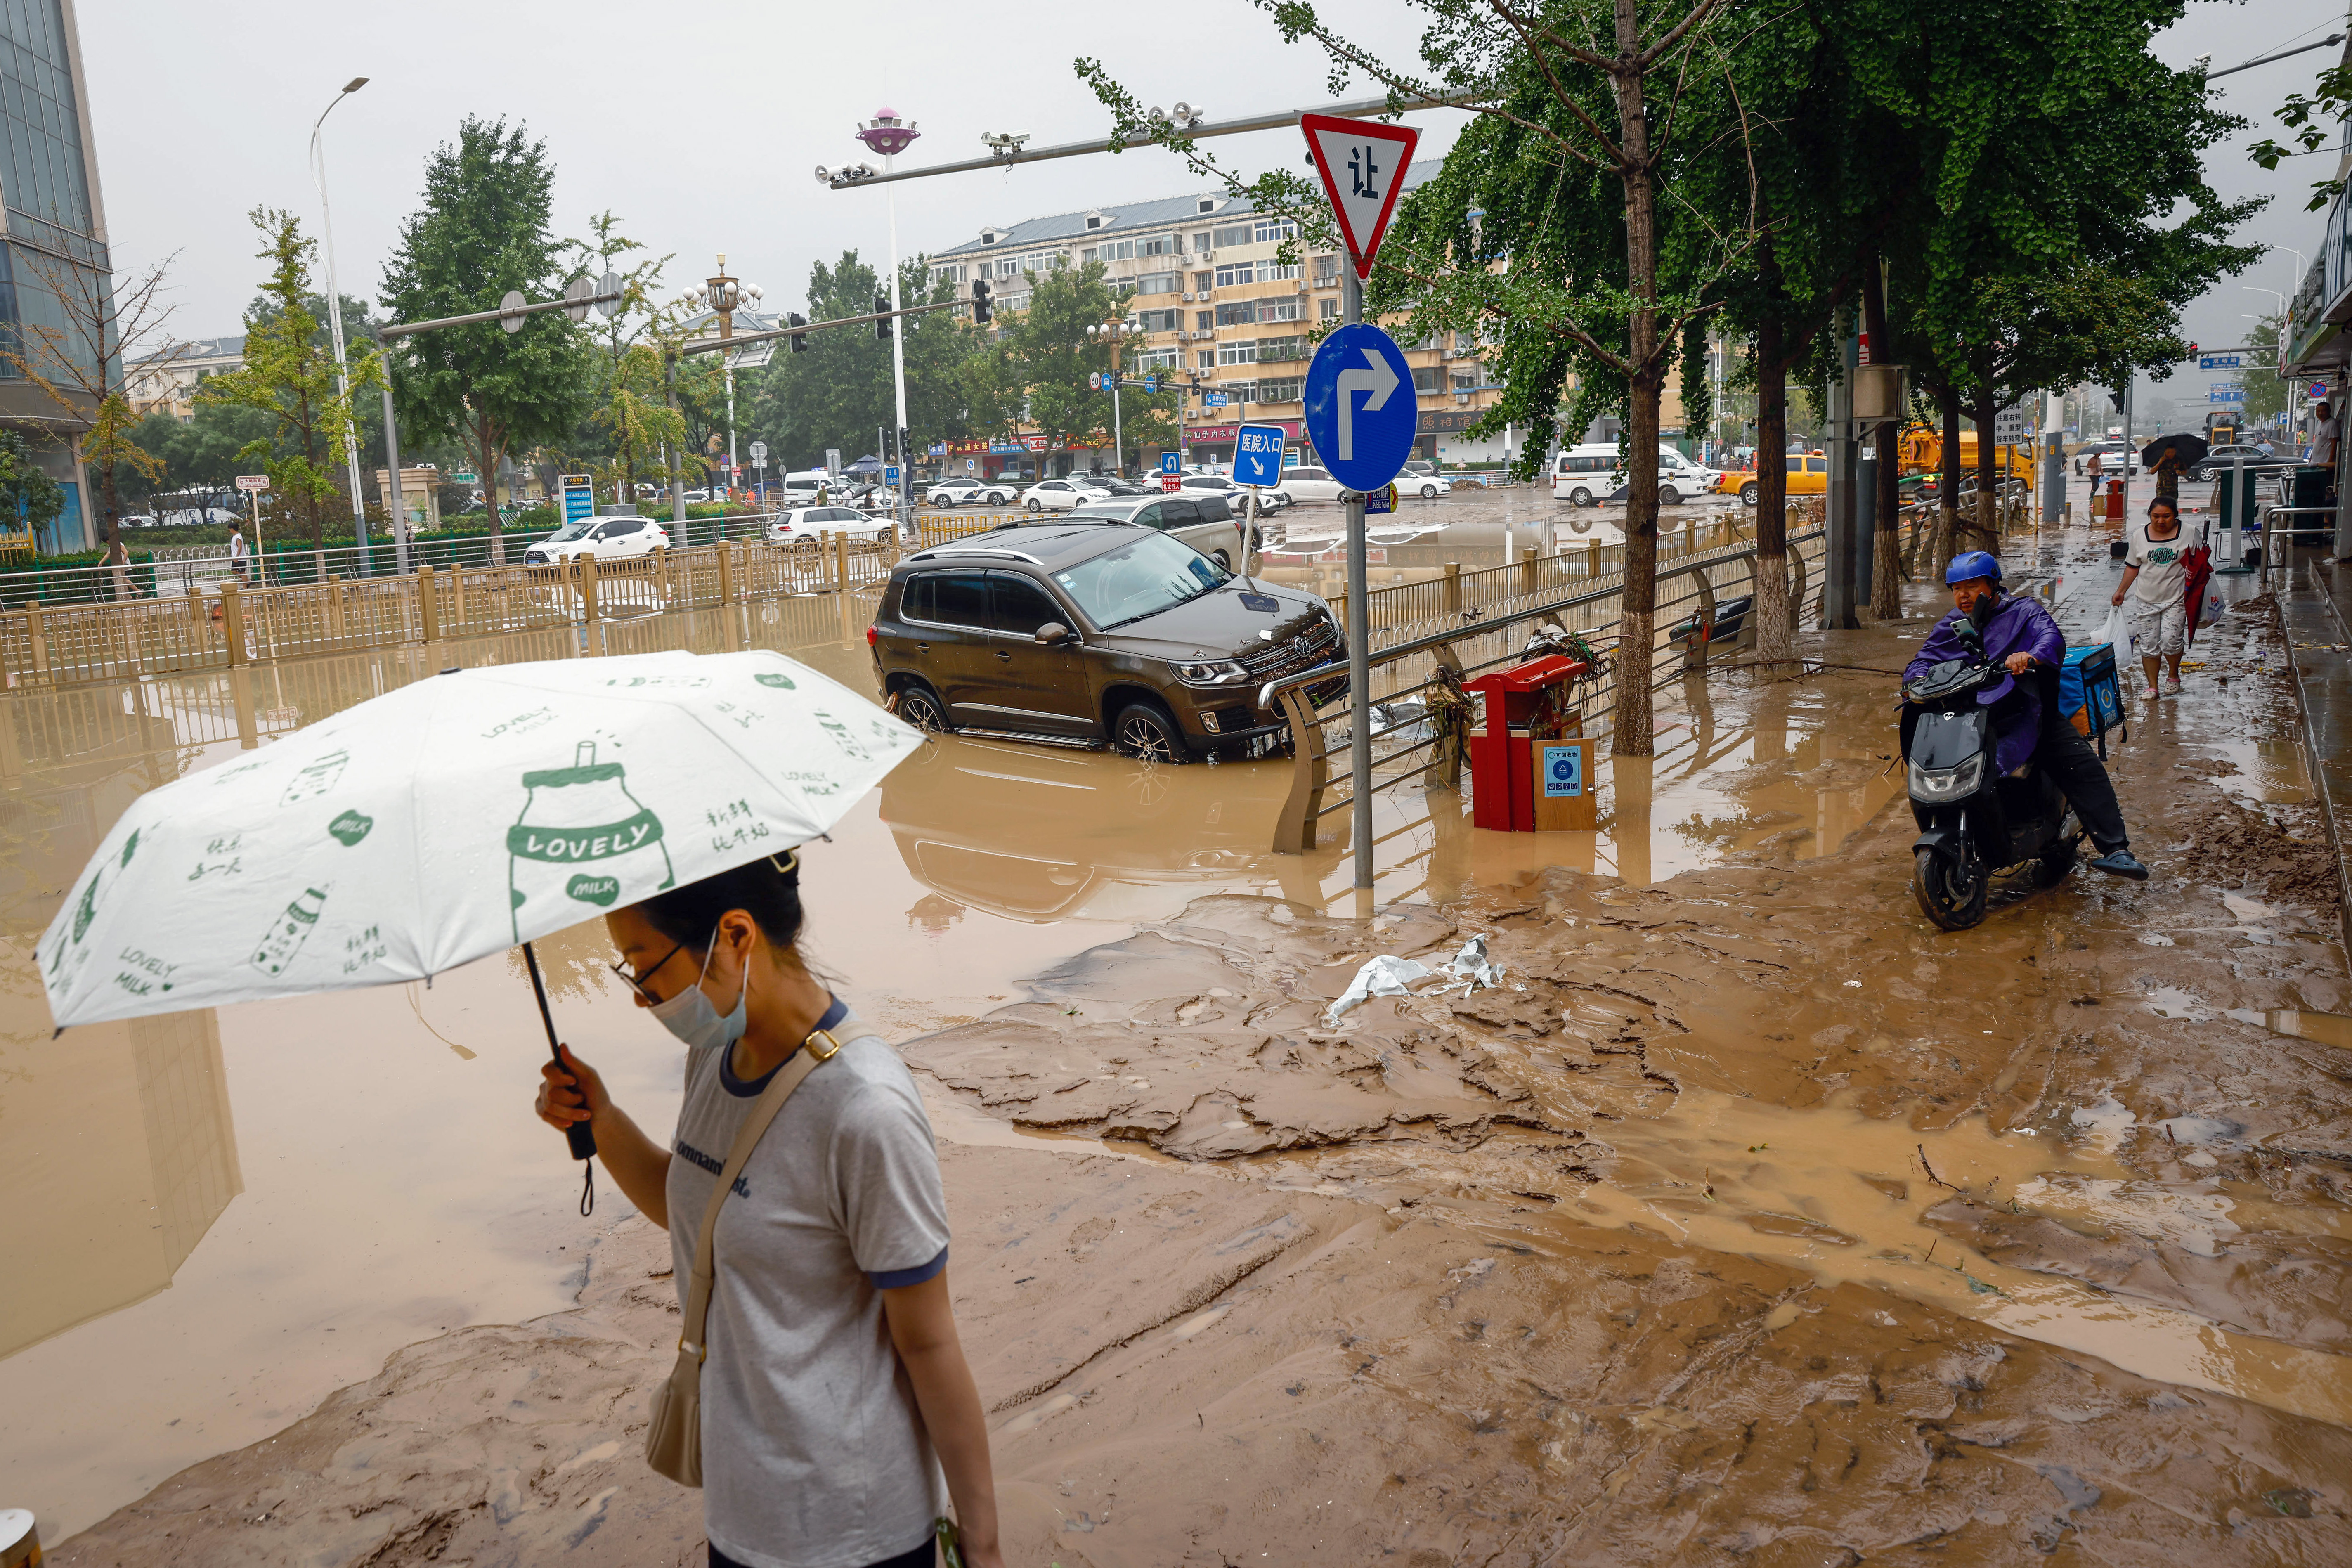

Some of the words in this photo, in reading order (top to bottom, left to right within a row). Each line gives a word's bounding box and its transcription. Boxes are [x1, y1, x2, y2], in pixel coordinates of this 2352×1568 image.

[1348, 146, 1378, 199] 让
[1997, 413, 2021, 421] 注意右转
[2279, 413, 2288, 423] P
[1996, 424, 2021, 433] 中、重型
[1241, 434, 1281, 453] 医院入口
[1996, 435, 2021, 443] 货车转弯
[1373, 487, 1389, 499] 公共厕所
[481, 706, 551, 738] LOVELY
[331, 819, 370, 834] MILK
[527, 823, 650, 858] LOVELY
[573, 880, 615, 896] MILK
[119, 946, 179, 979] LOVELY
[113, 972, 153, 996] MILK
